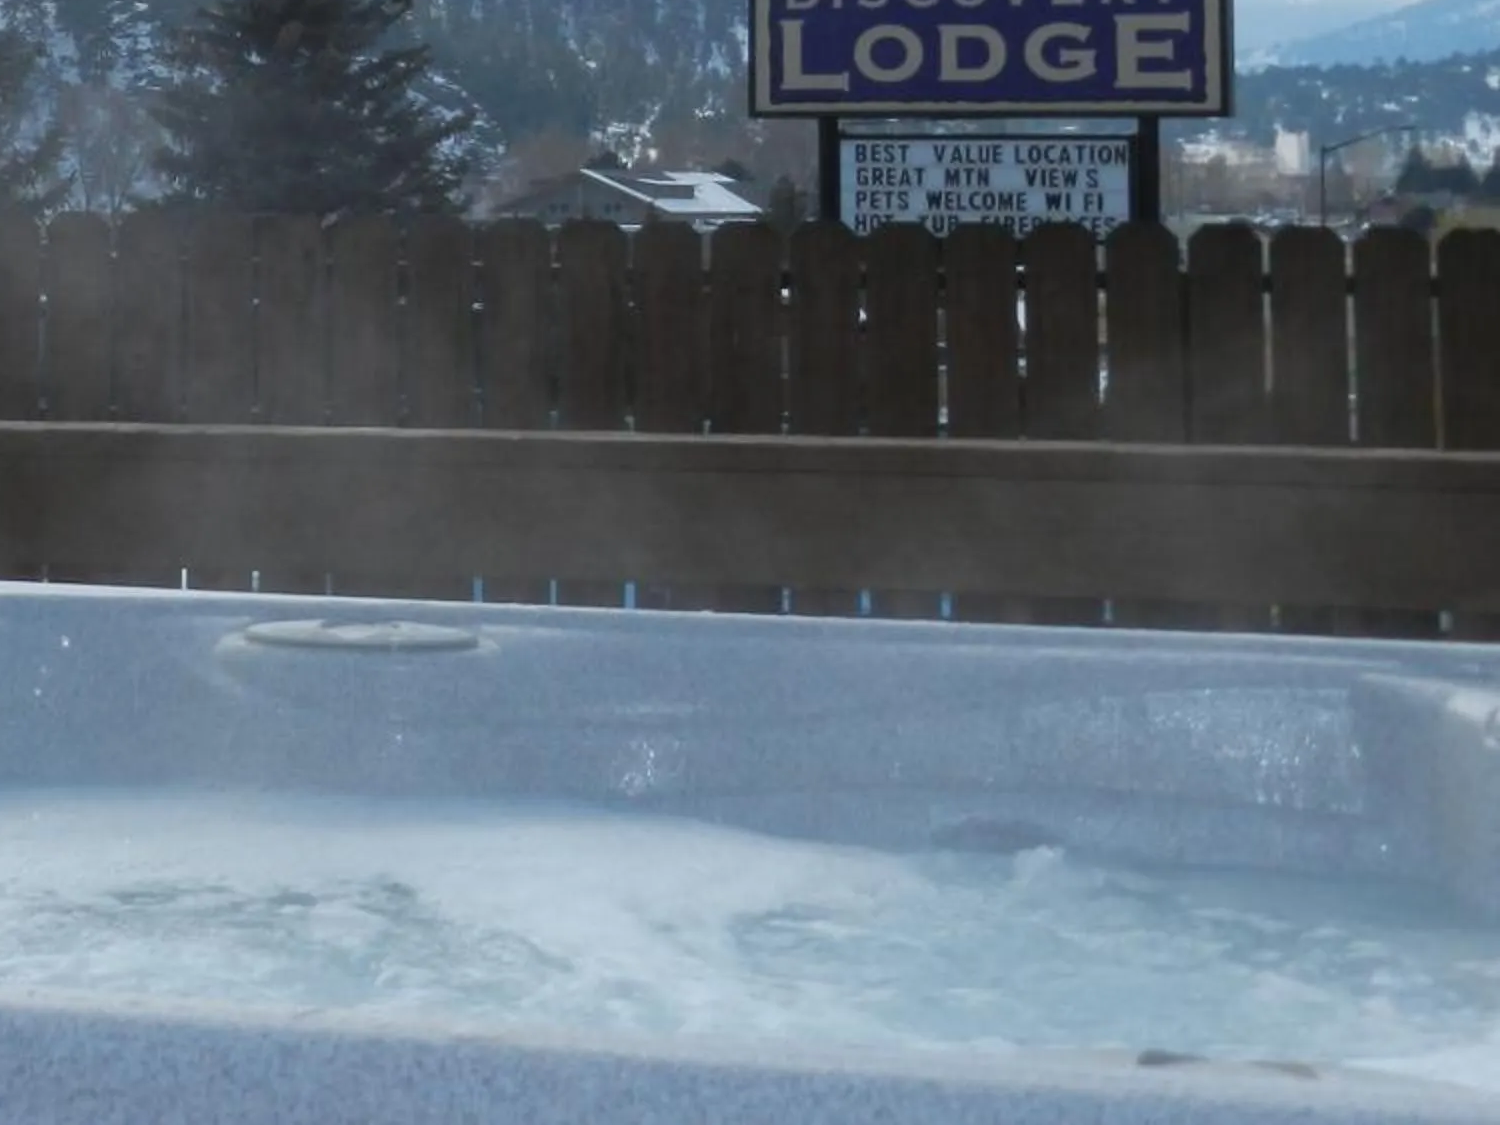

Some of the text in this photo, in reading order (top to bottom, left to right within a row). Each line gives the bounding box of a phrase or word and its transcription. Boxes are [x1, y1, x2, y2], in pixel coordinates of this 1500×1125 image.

[779, 10, 1192, 92] LODGE
[854, 143, 1127, 165] BEST VALUE LOCATION
[856, 167, 926, 188] GREAT
[944, 167, 990, 188] MTN
[855, 190, 910, 211] PETS
[926, 190, 1028, 212] WELCOME
